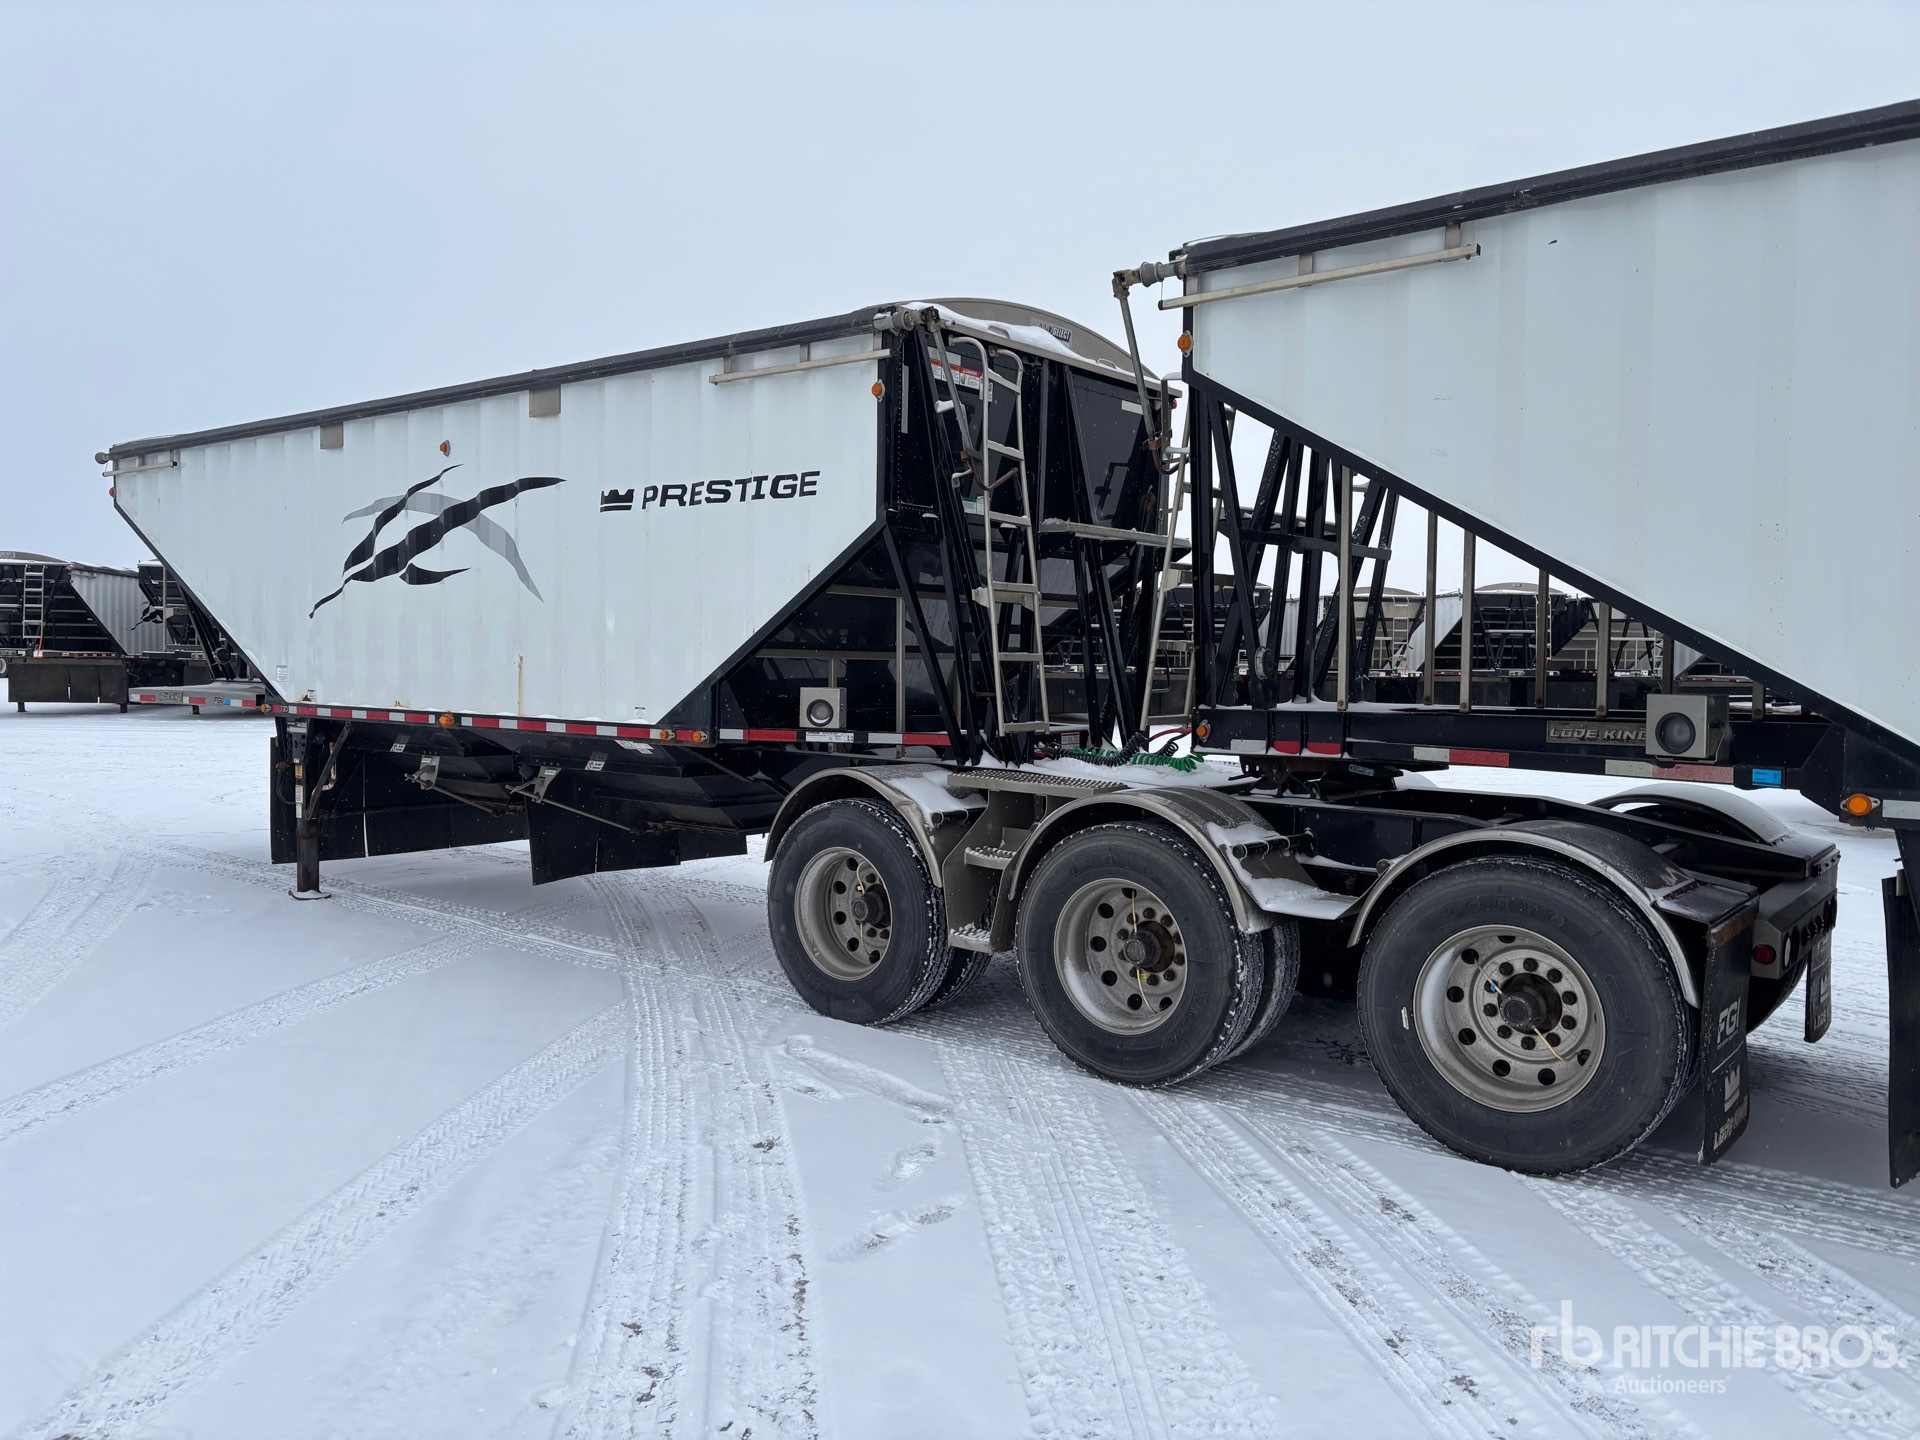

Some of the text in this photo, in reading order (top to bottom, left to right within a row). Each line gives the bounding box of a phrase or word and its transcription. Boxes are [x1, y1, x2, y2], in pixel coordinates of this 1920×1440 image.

[641, 470, 820, 510] PRESTIGE
[1549, 727, 1598, 739] LODE
[1717, 997, 1741, 1045] FGI
